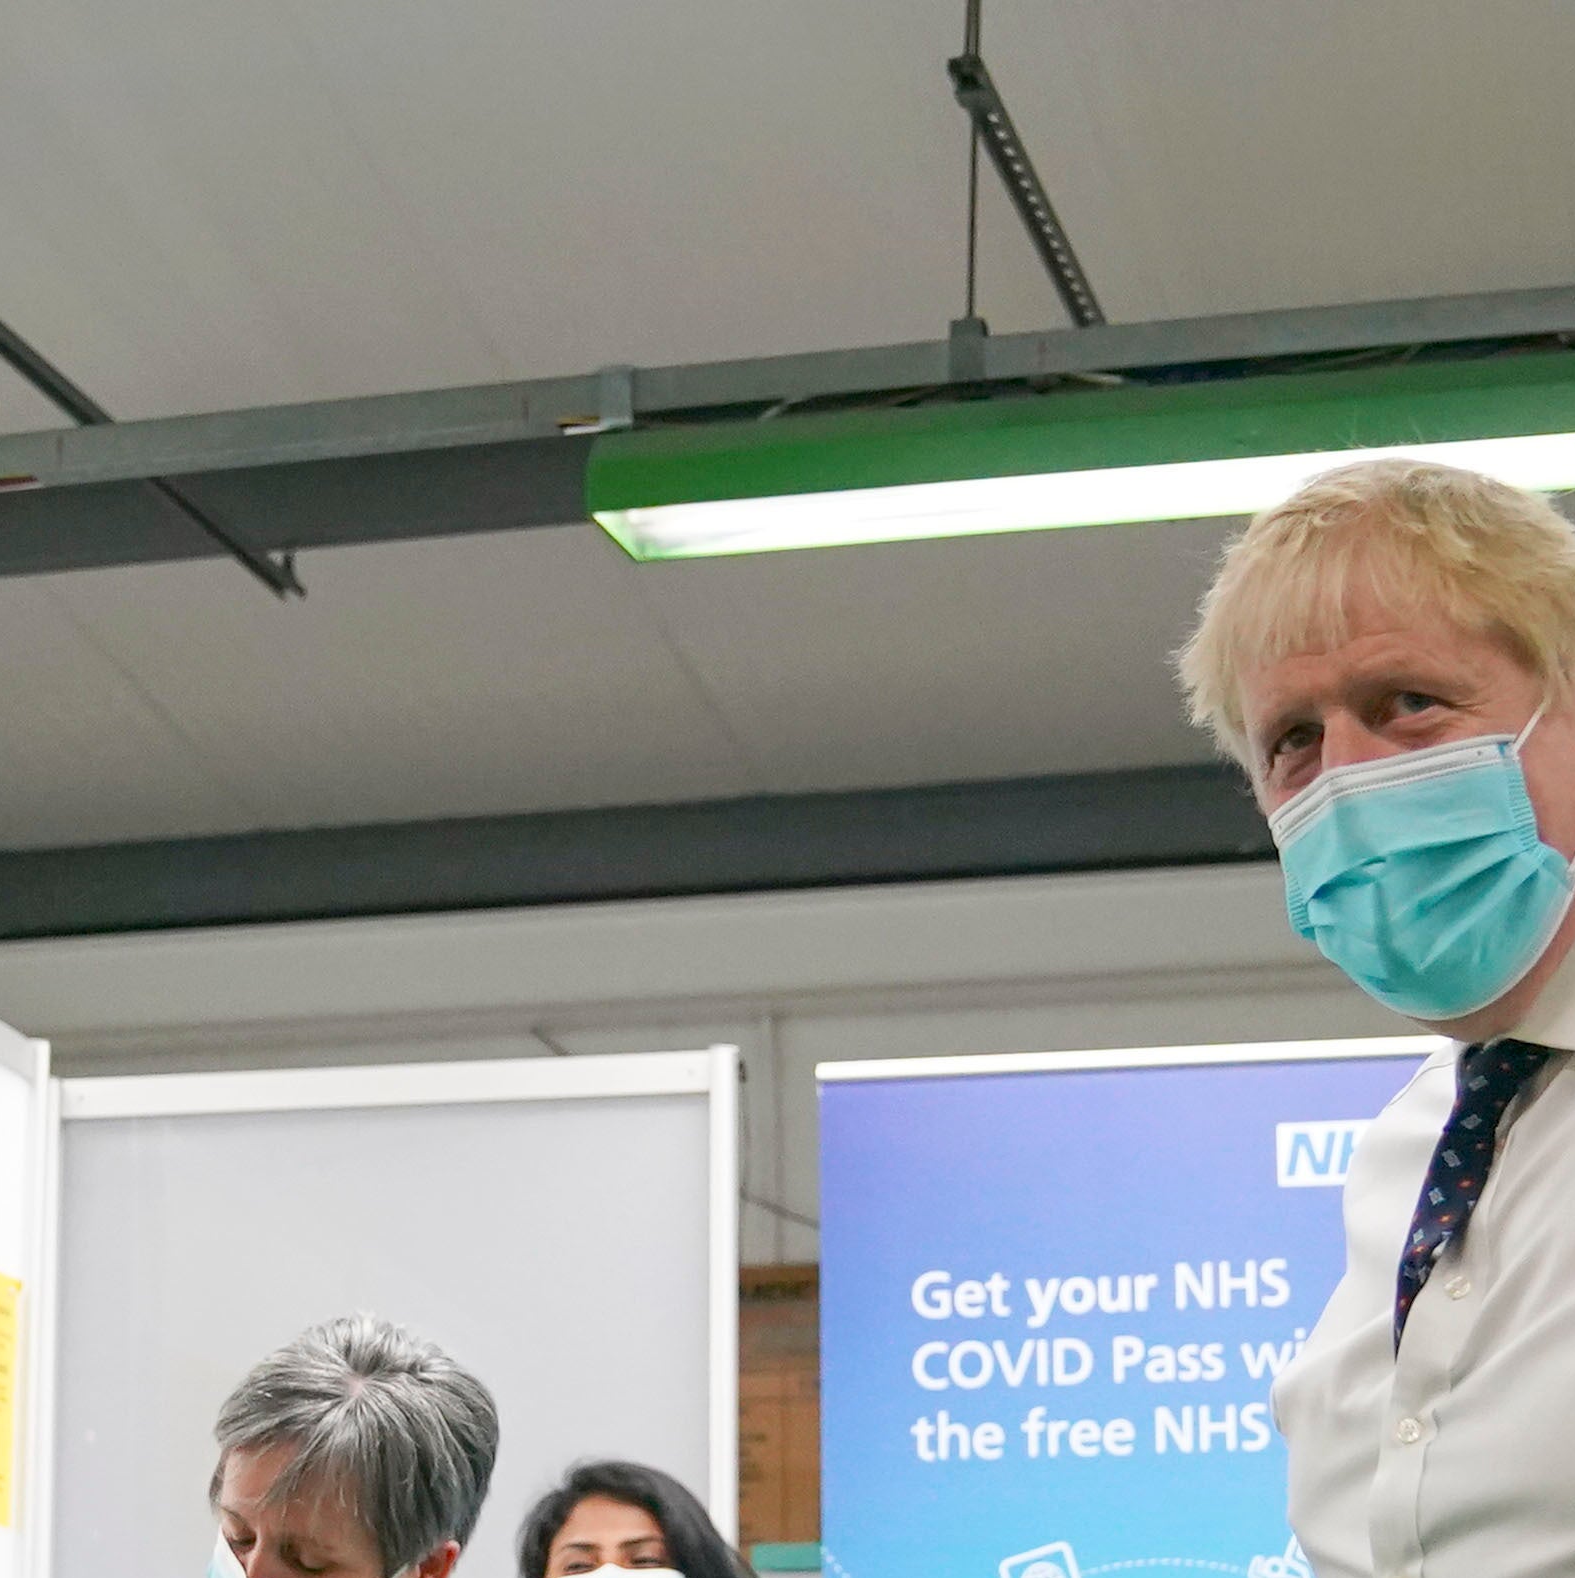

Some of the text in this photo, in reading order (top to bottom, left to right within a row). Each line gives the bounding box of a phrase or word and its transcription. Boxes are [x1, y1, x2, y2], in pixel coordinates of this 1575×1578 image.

[911, 1259, 1291, 1328] Get your NHS
[911, 1338, 1093, 1391] COVID
[1112, 1335, 1226, 1385] Pass
[910, 1403, 1272, 1462] the free NHS
